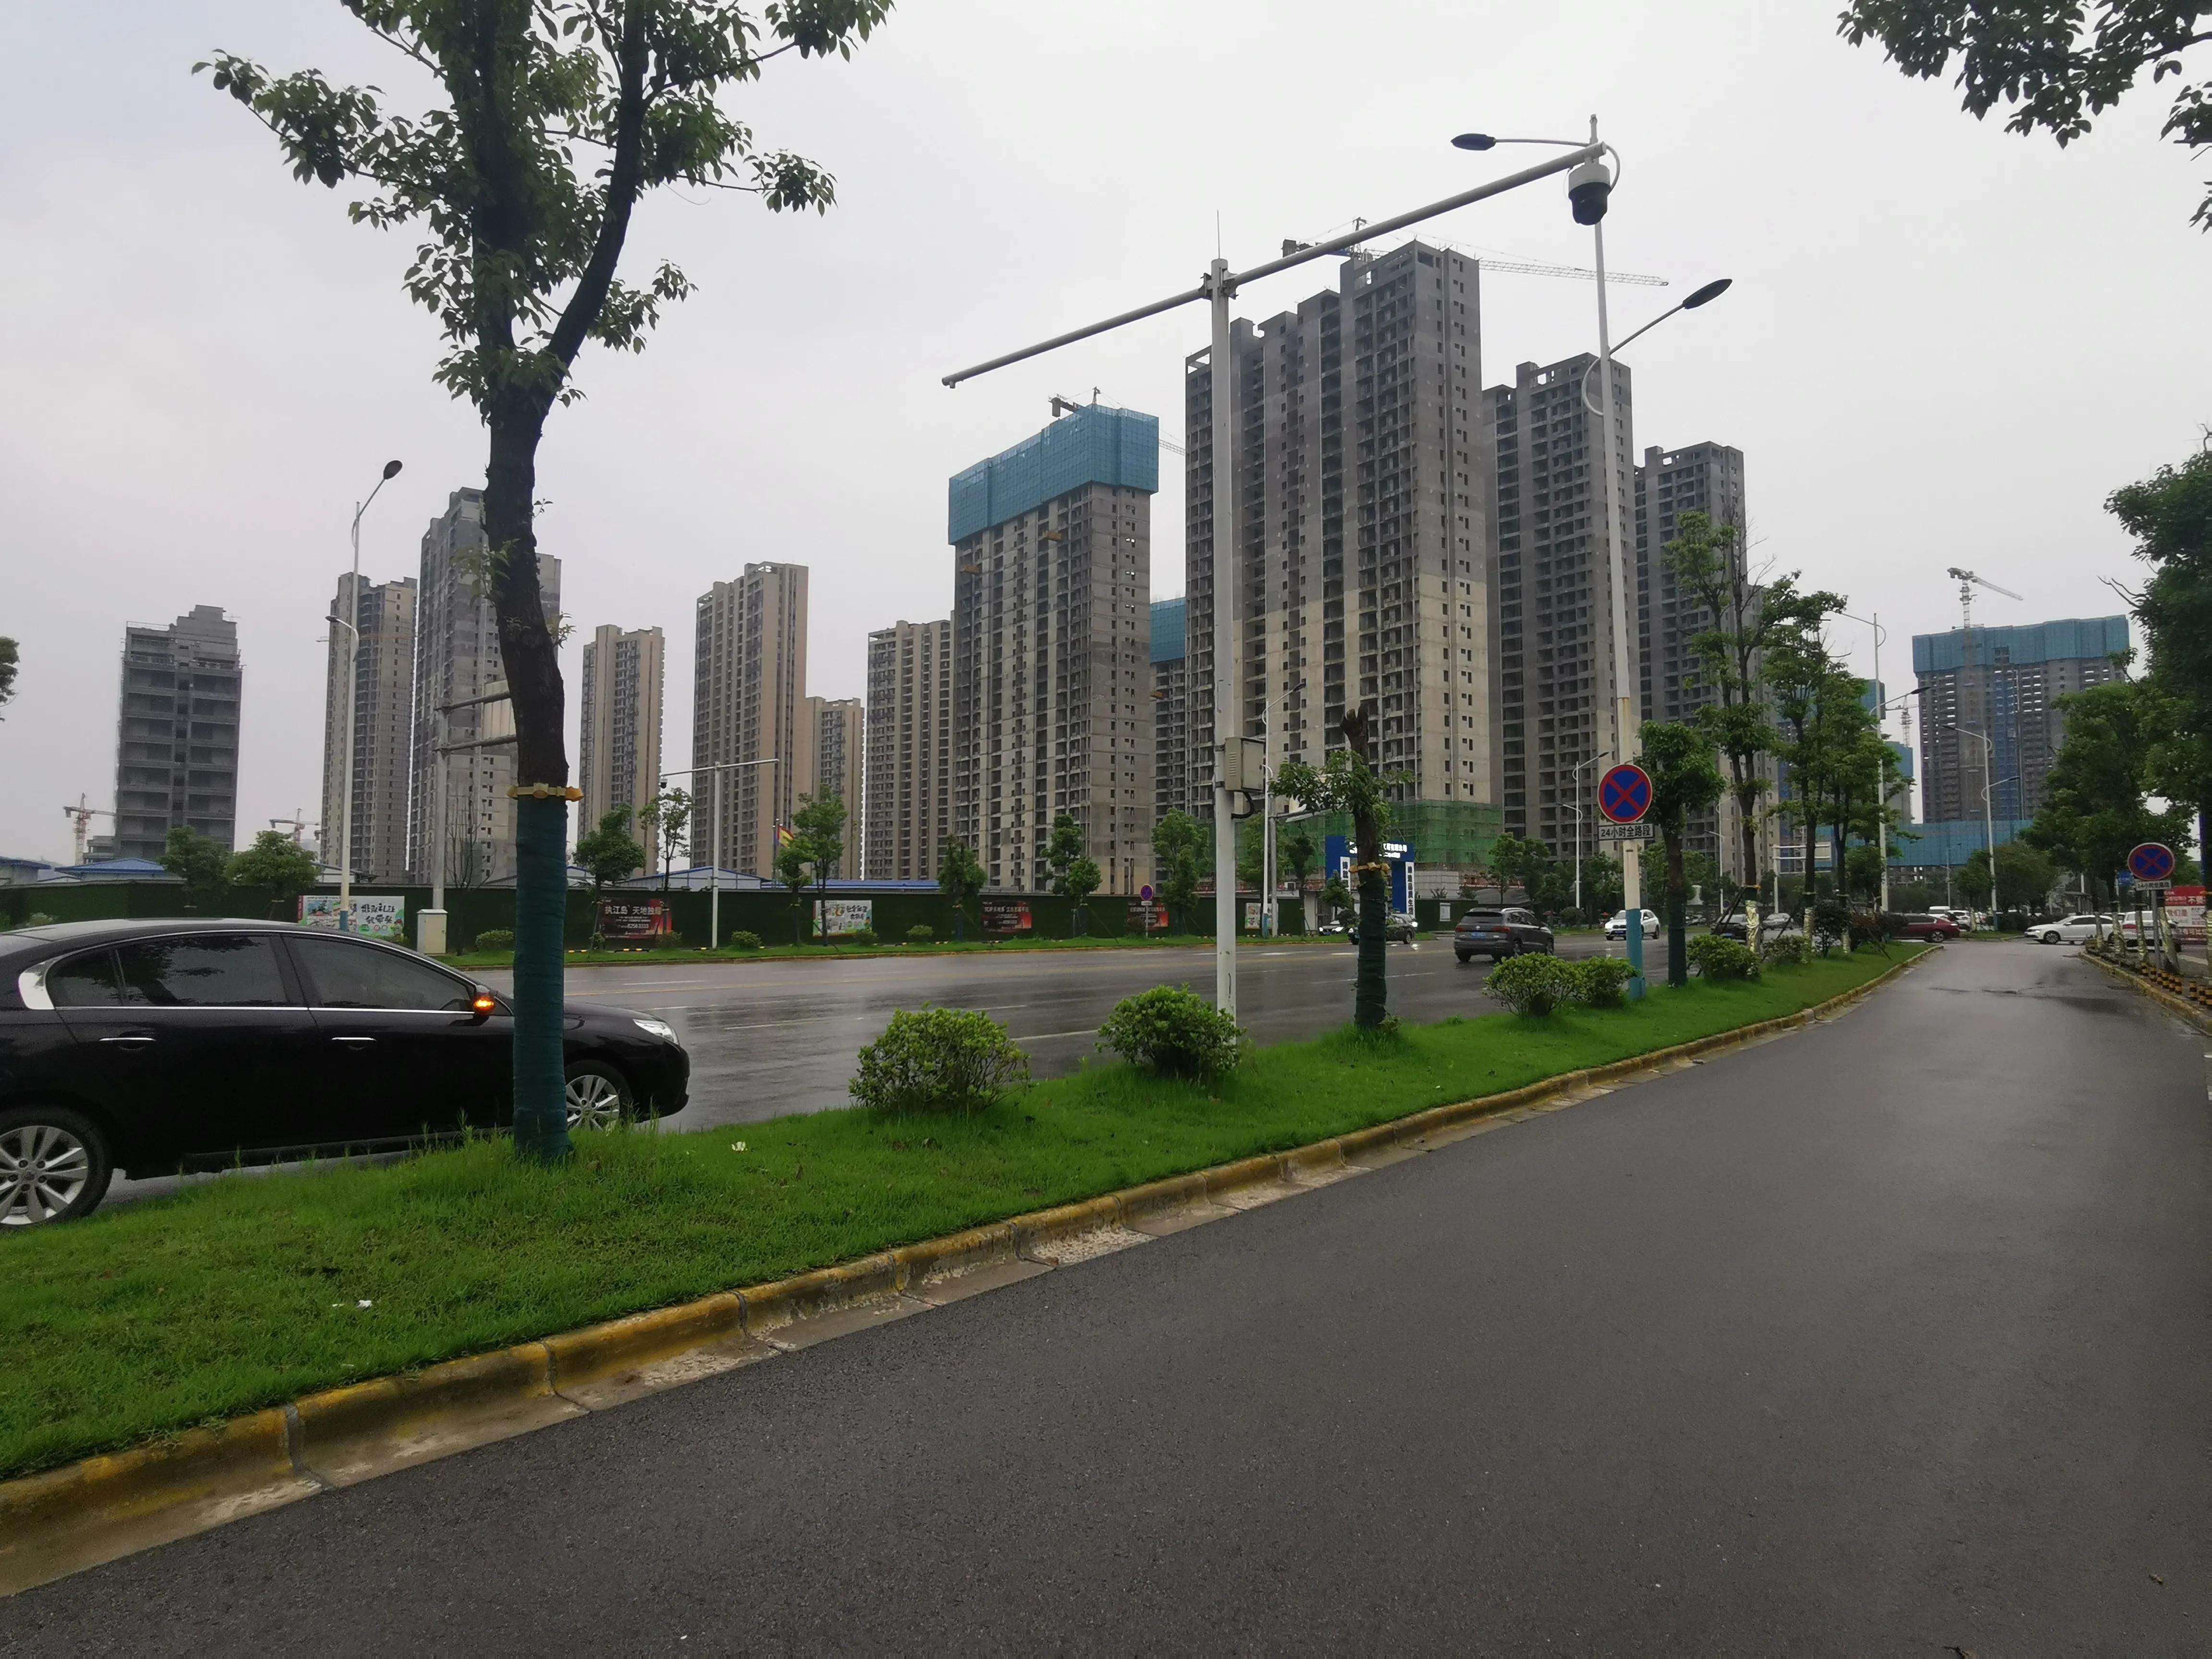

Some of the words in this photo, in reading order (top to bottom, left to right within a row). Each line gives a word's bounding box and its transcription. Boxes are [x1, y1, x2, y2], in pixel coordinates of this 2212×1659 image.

[1601, 825, 1650, 838] 24小时全路段
